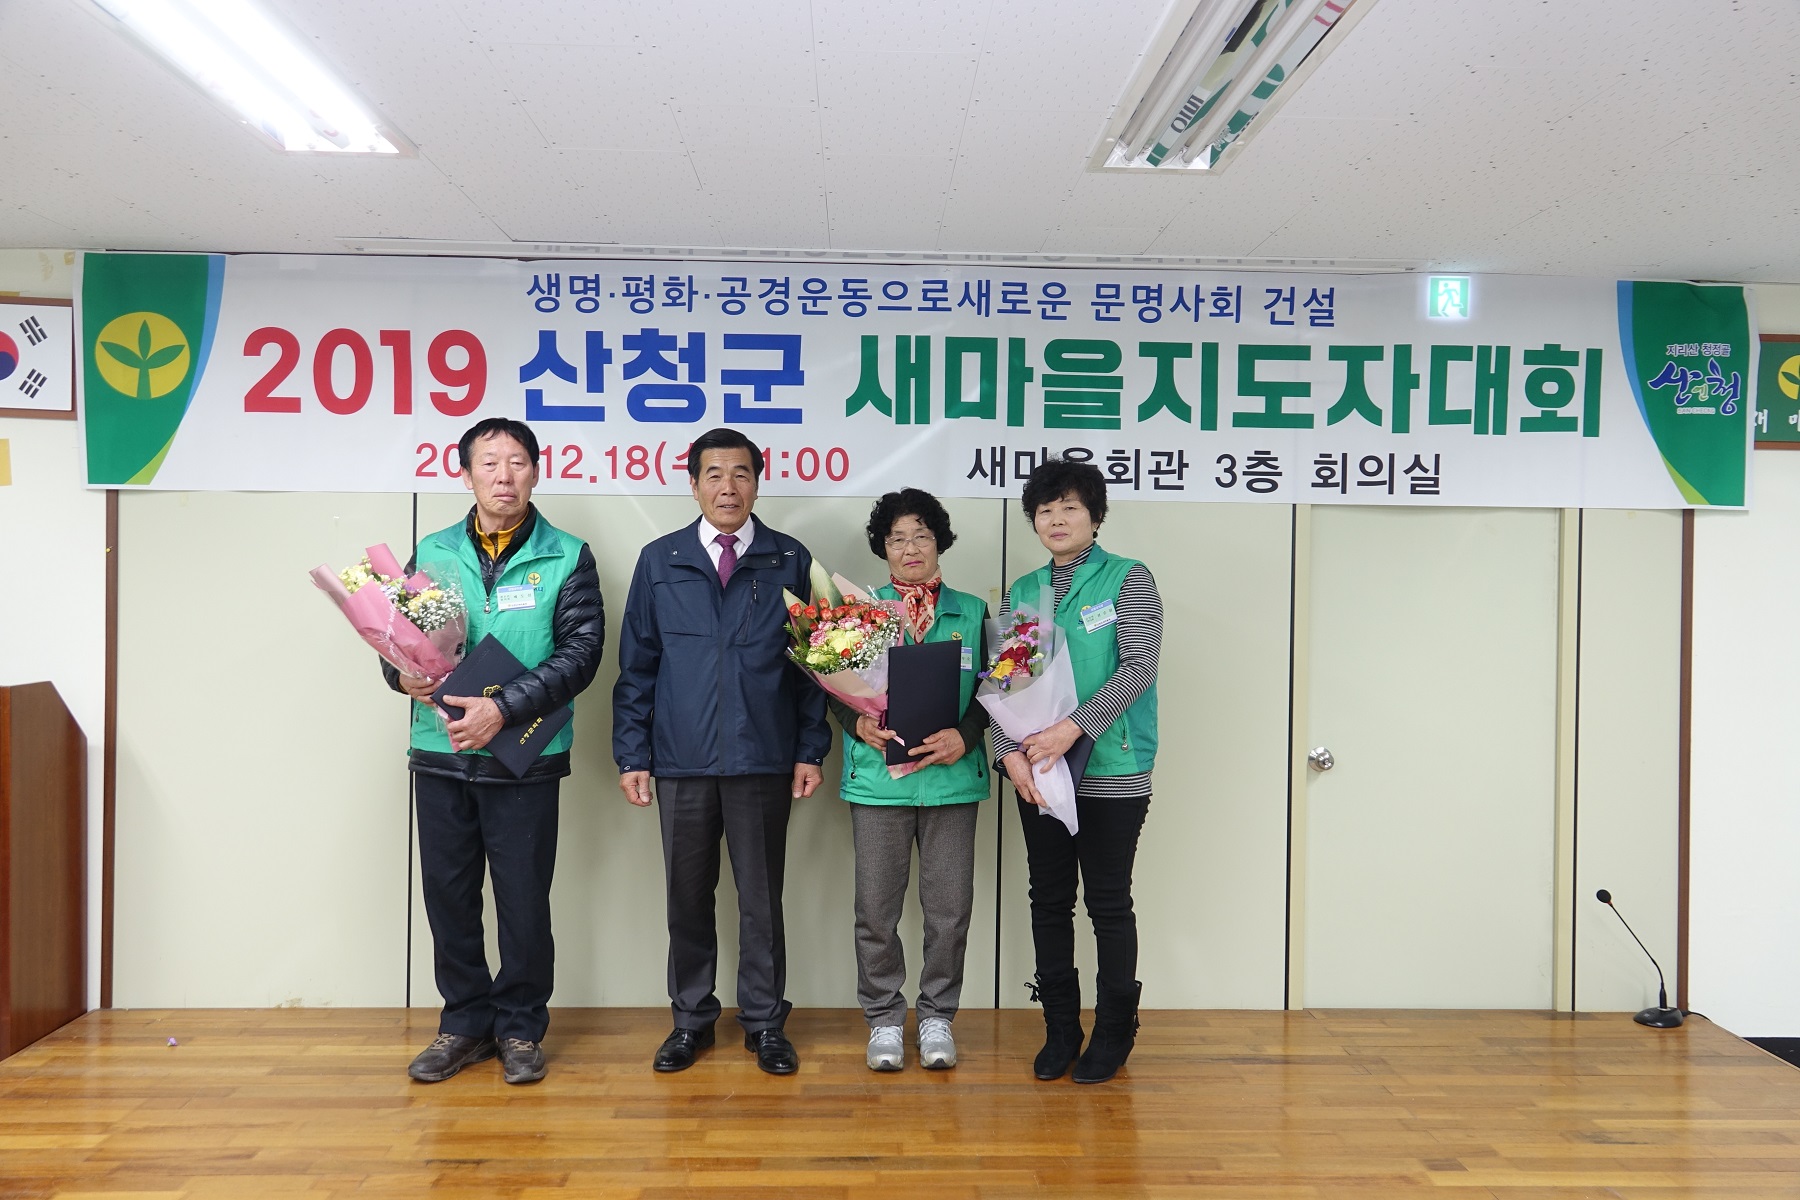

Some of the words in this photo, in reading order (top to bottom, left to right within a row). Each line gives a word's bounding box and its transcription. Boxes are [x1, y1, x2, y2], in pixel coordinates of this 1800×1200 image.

[1090, 283, 1242, 325] 문명사회
[1263, 286, 1335, 328] 건설
[1667, 343, 1699, 357] 지리산
[1702, 343, 1731, 357] 청정골
[243, 326, 488, 417] 2019
[519, 327, 805, 425] 산청군
[845, 335, 1603, 438] 새마을지도자대회
[1215, 450, 1283, 494] 3층
[1311, 452, 1441, 495] 회의실
